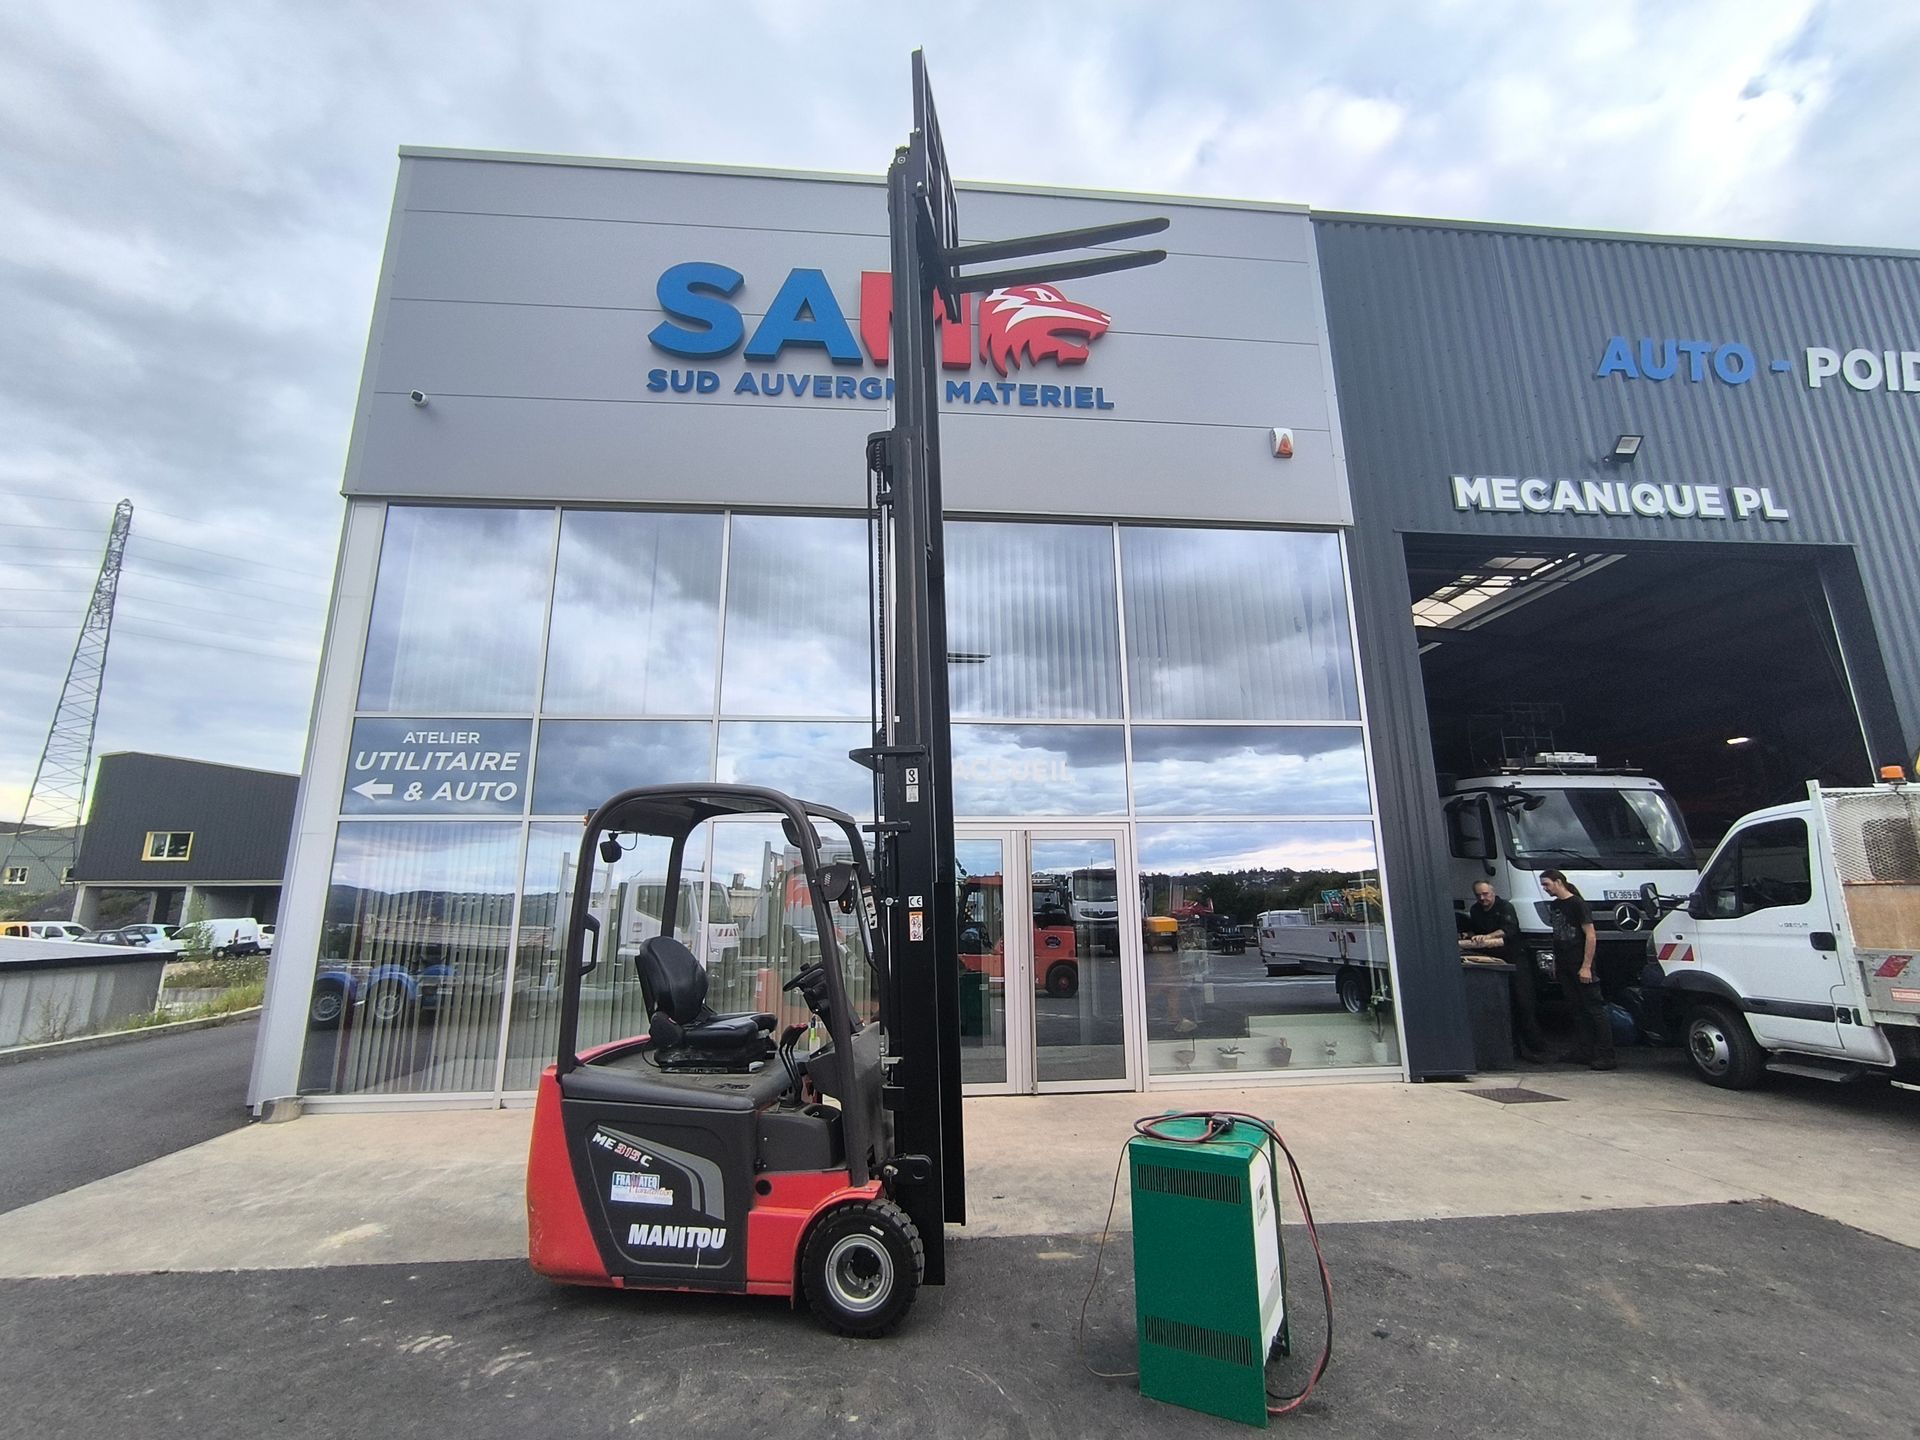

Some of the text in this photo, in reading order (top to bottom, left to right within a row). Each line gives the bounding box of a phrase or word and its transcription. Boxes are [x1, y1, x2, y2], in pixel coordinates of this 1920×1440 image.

[1597, 335, 1755, 384] AUTO
[646, 369, 721, 394] SUD
[945, 380, 1115, 409] MATERIEL
[1451, 474, 1789, 521] MECANIQUE PL
[403, 732, 480, 744] ATELIER
[355, 751, 521, 771] UTILITAIRE
[403, 781, 518, 801] & AUTO
[628, 1223, 727, 1249] MANITOU
